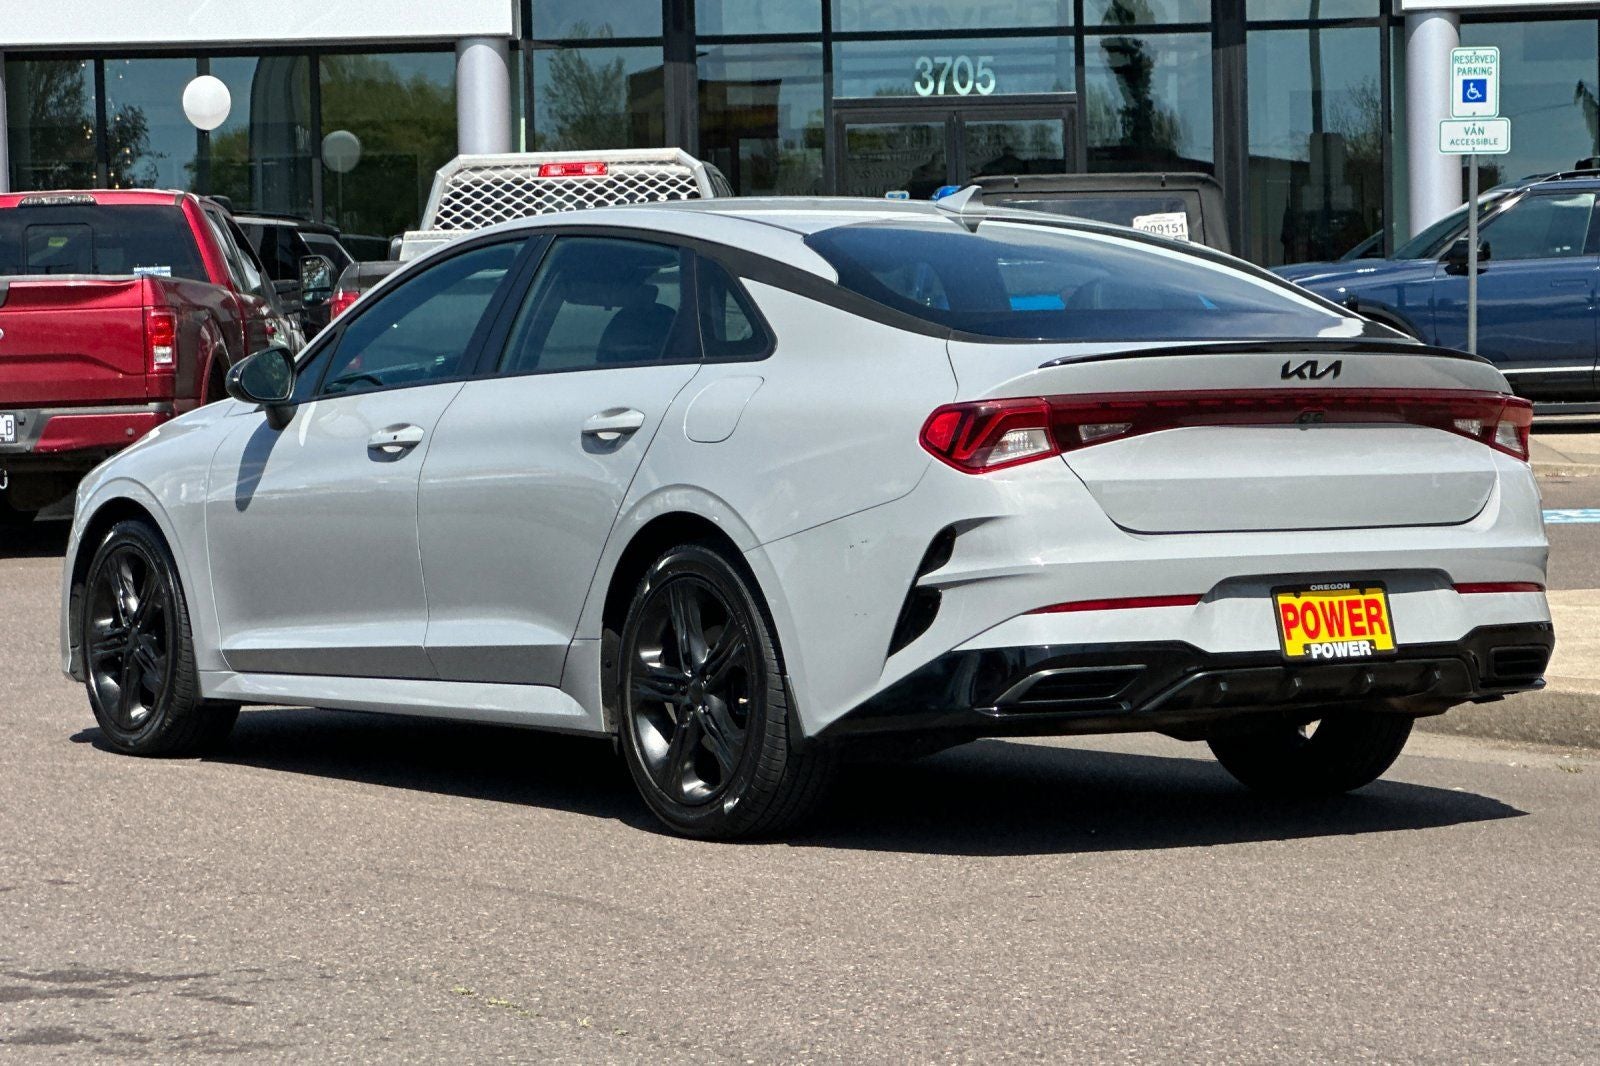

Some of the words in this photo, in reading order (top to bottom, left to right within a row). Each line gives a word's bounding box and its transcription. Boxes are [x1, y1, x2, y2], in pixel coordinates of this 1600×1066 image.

[1454, 55, 1495, 64] RESERVED
[914, 55, 996, 96] 3705
[1457, 67, 1493, 76] PARKING
[1464, 126, 1485, 135] VAN
[1281, 360, 1342, 380] KIA
[1310, 582, 1351, 591] OREGON
[1280, 599, 1387, 640] POWER
[1310, 640, 1372, 659] POWER
